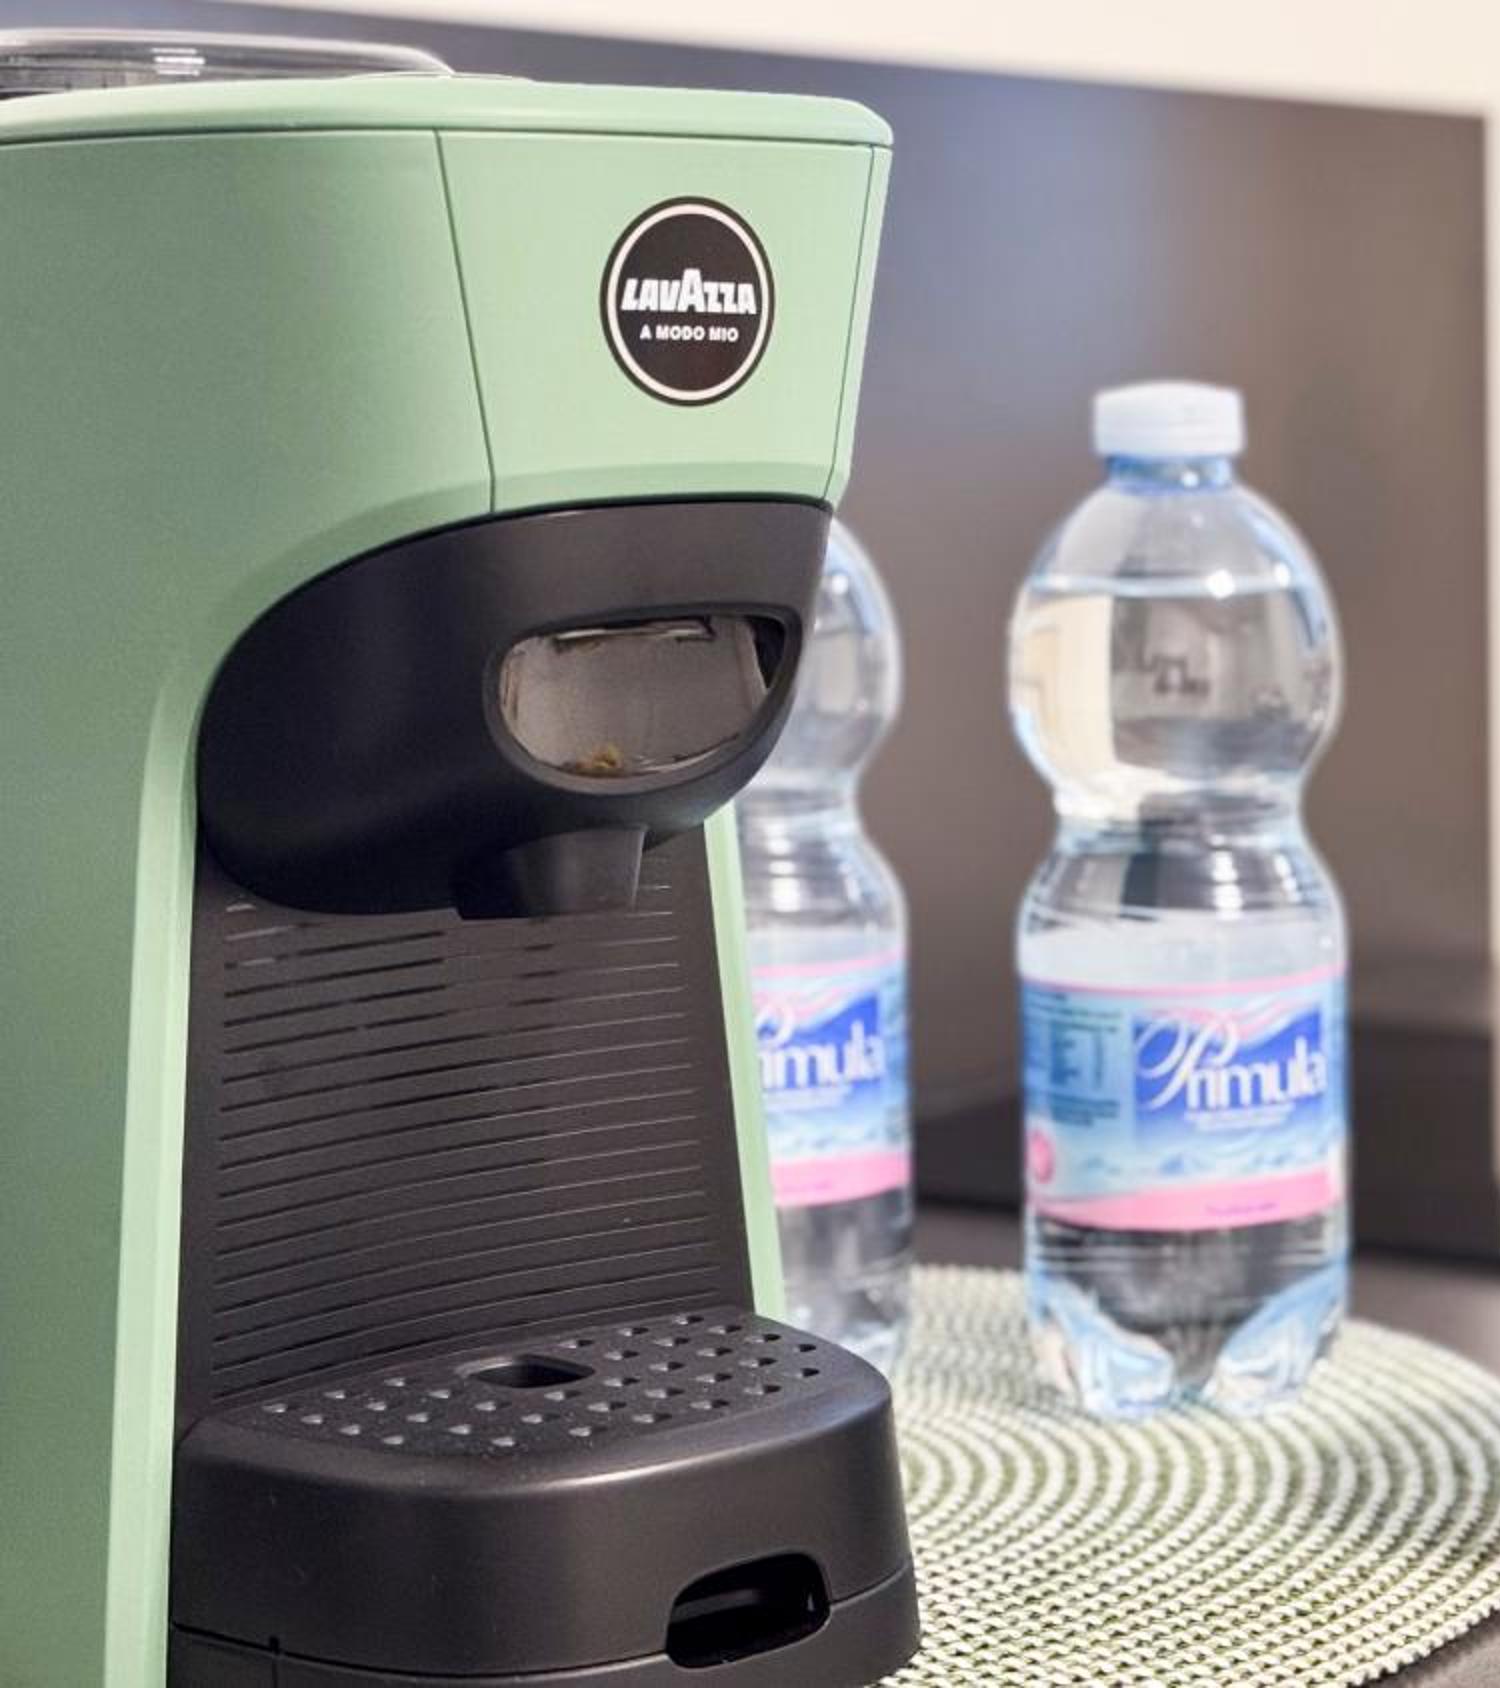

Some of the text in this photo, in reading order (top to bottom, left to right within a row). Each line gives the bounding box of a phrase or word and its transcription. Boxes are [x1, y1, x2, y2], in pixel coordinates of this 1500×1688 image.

[620, 267, 757, 315] LAVAZZA
[639, 324, 739, 342] A MODO MIO
